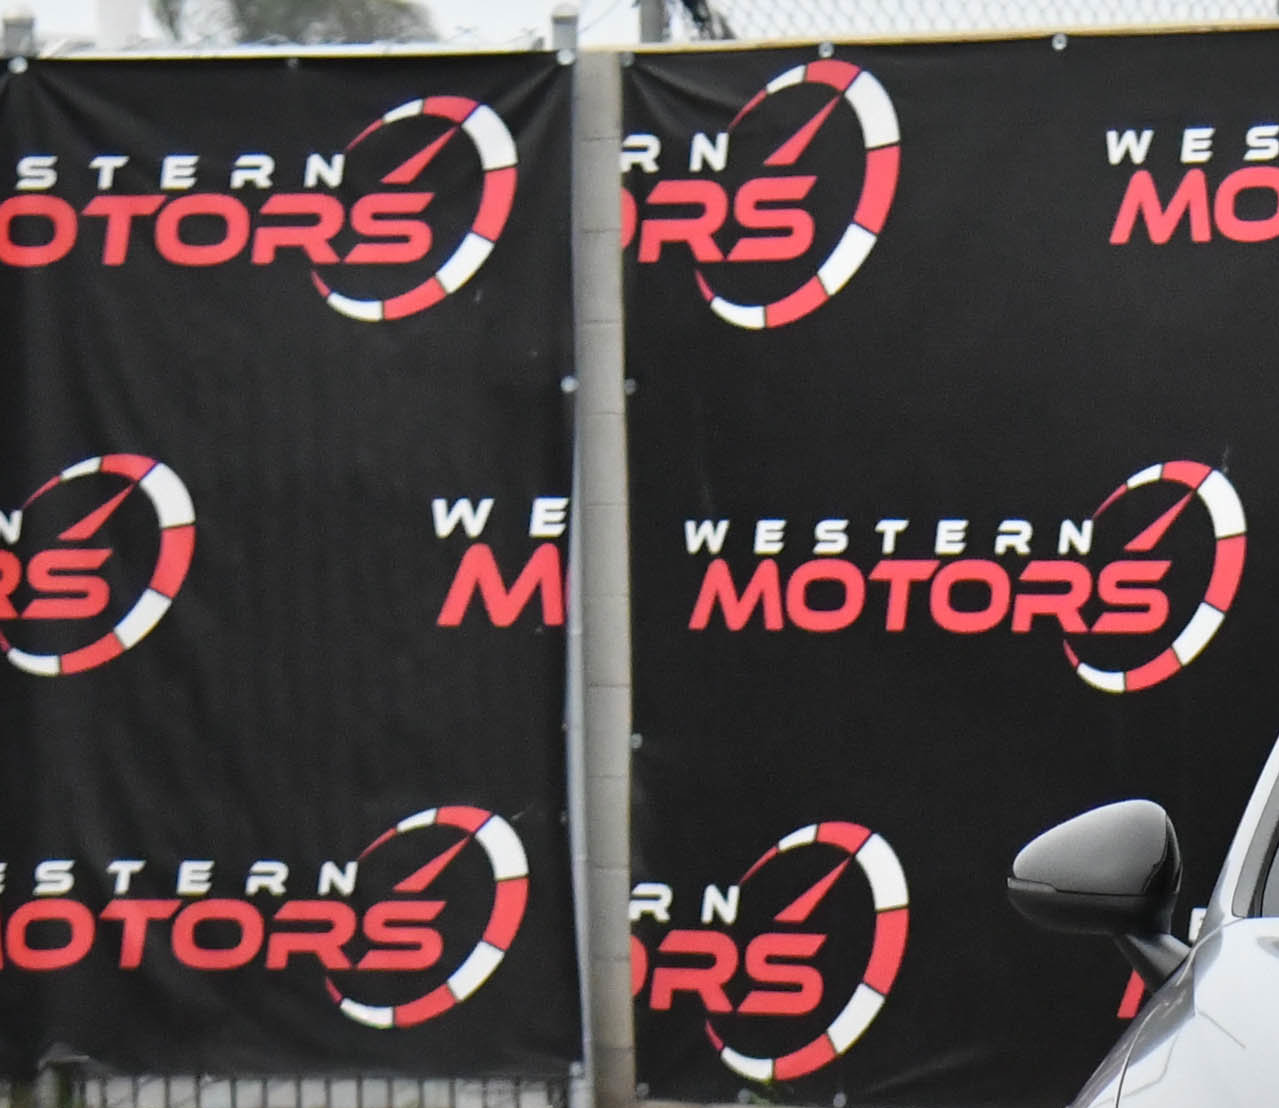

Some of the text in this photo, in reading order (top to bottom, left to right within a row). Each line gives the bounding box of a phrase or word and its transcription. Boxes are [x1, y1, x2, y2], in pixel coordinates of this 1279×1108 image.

[683, 517, 1095, 556] WESTERN
[686, 556, 1173, 636] MOTORS
[0, 858, 360, 897] STERN
